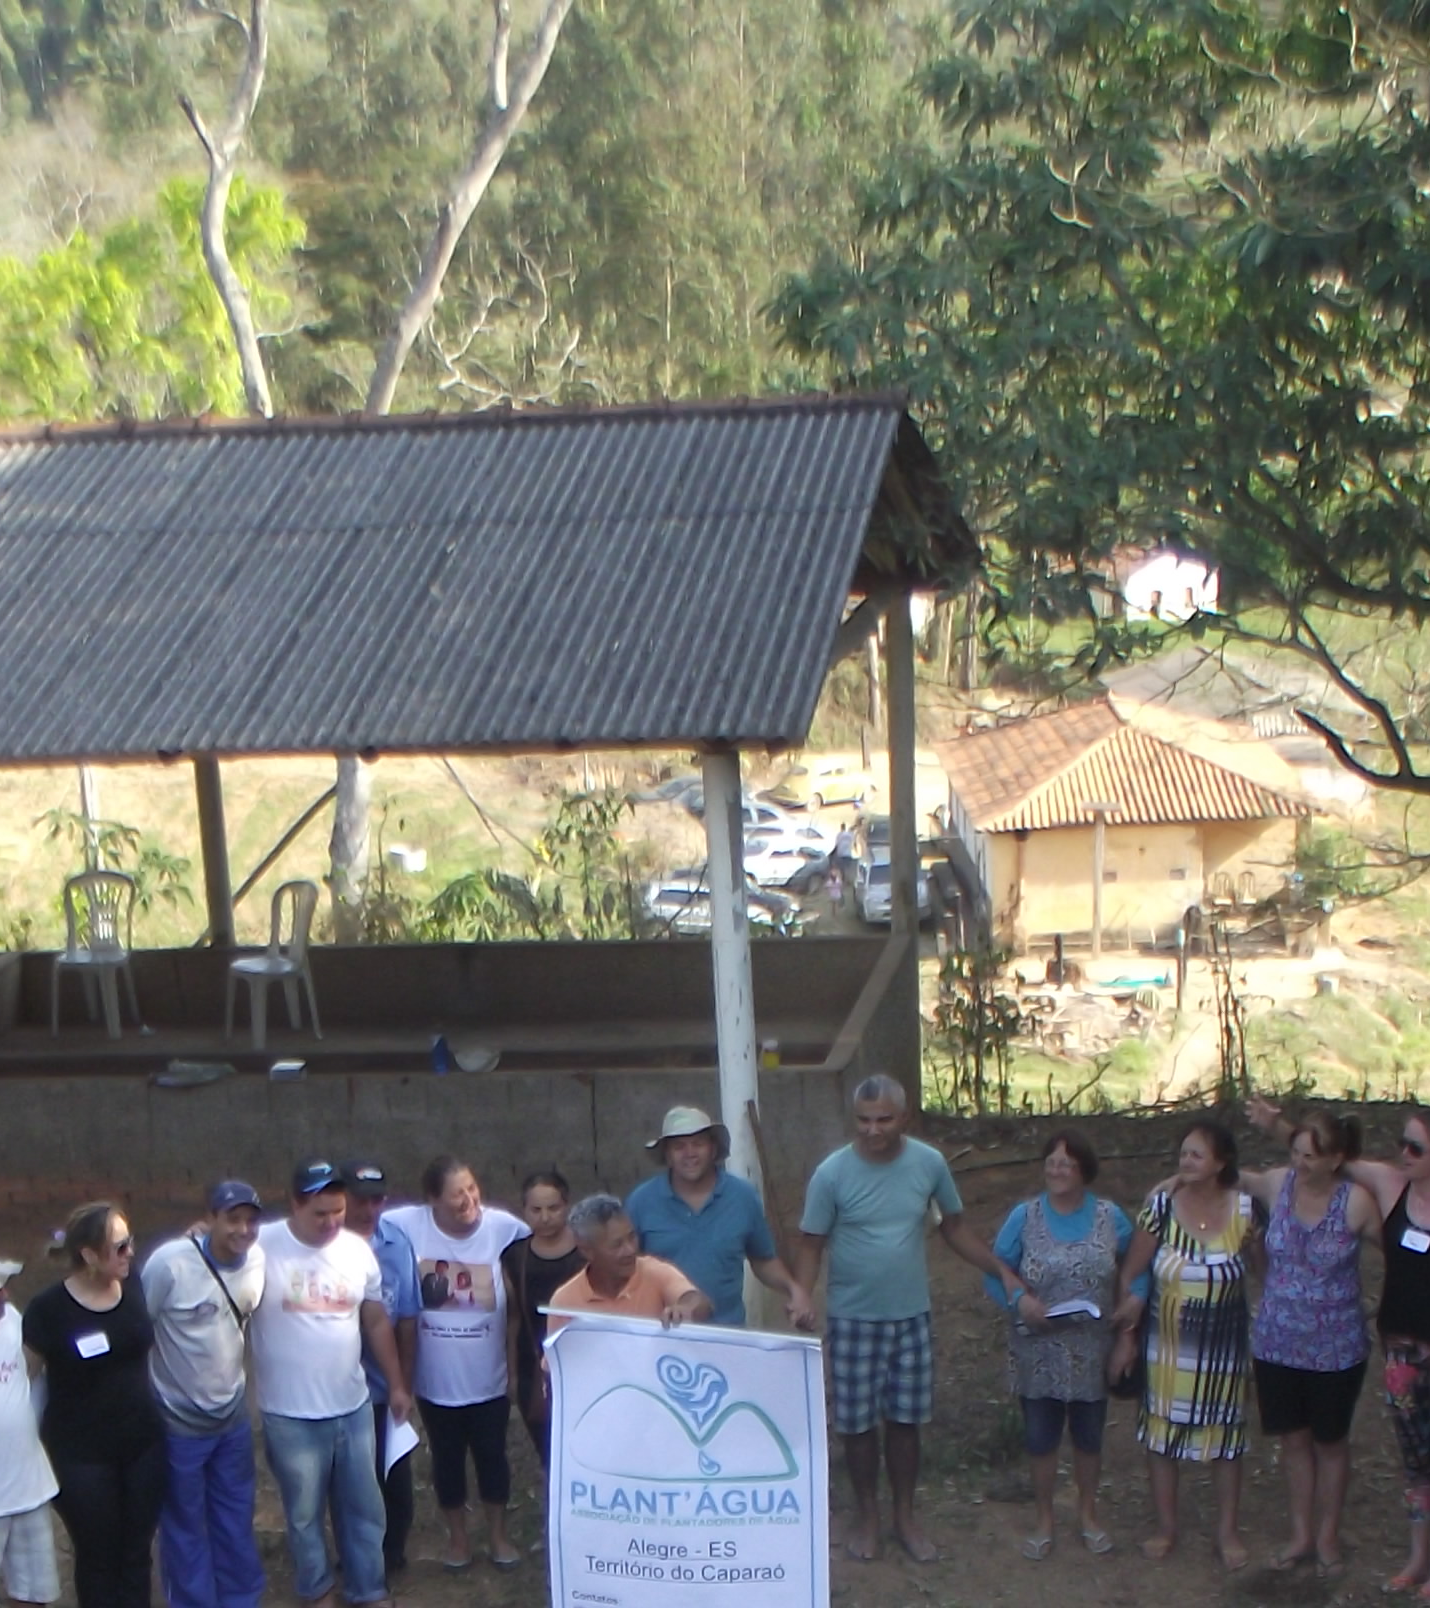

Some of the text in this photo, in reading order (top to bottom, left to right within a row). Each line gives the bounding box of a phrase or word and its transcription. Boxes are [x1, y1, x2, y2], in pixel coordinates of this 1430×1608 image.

[570, 1481, 801, 1517] PLANT'ÁGUA
[627, 1538, 688, 1560] Alegre
[708, 1540, 738, 1558] ES
[585, 1554, 786, 1584] Território do Caparaó
